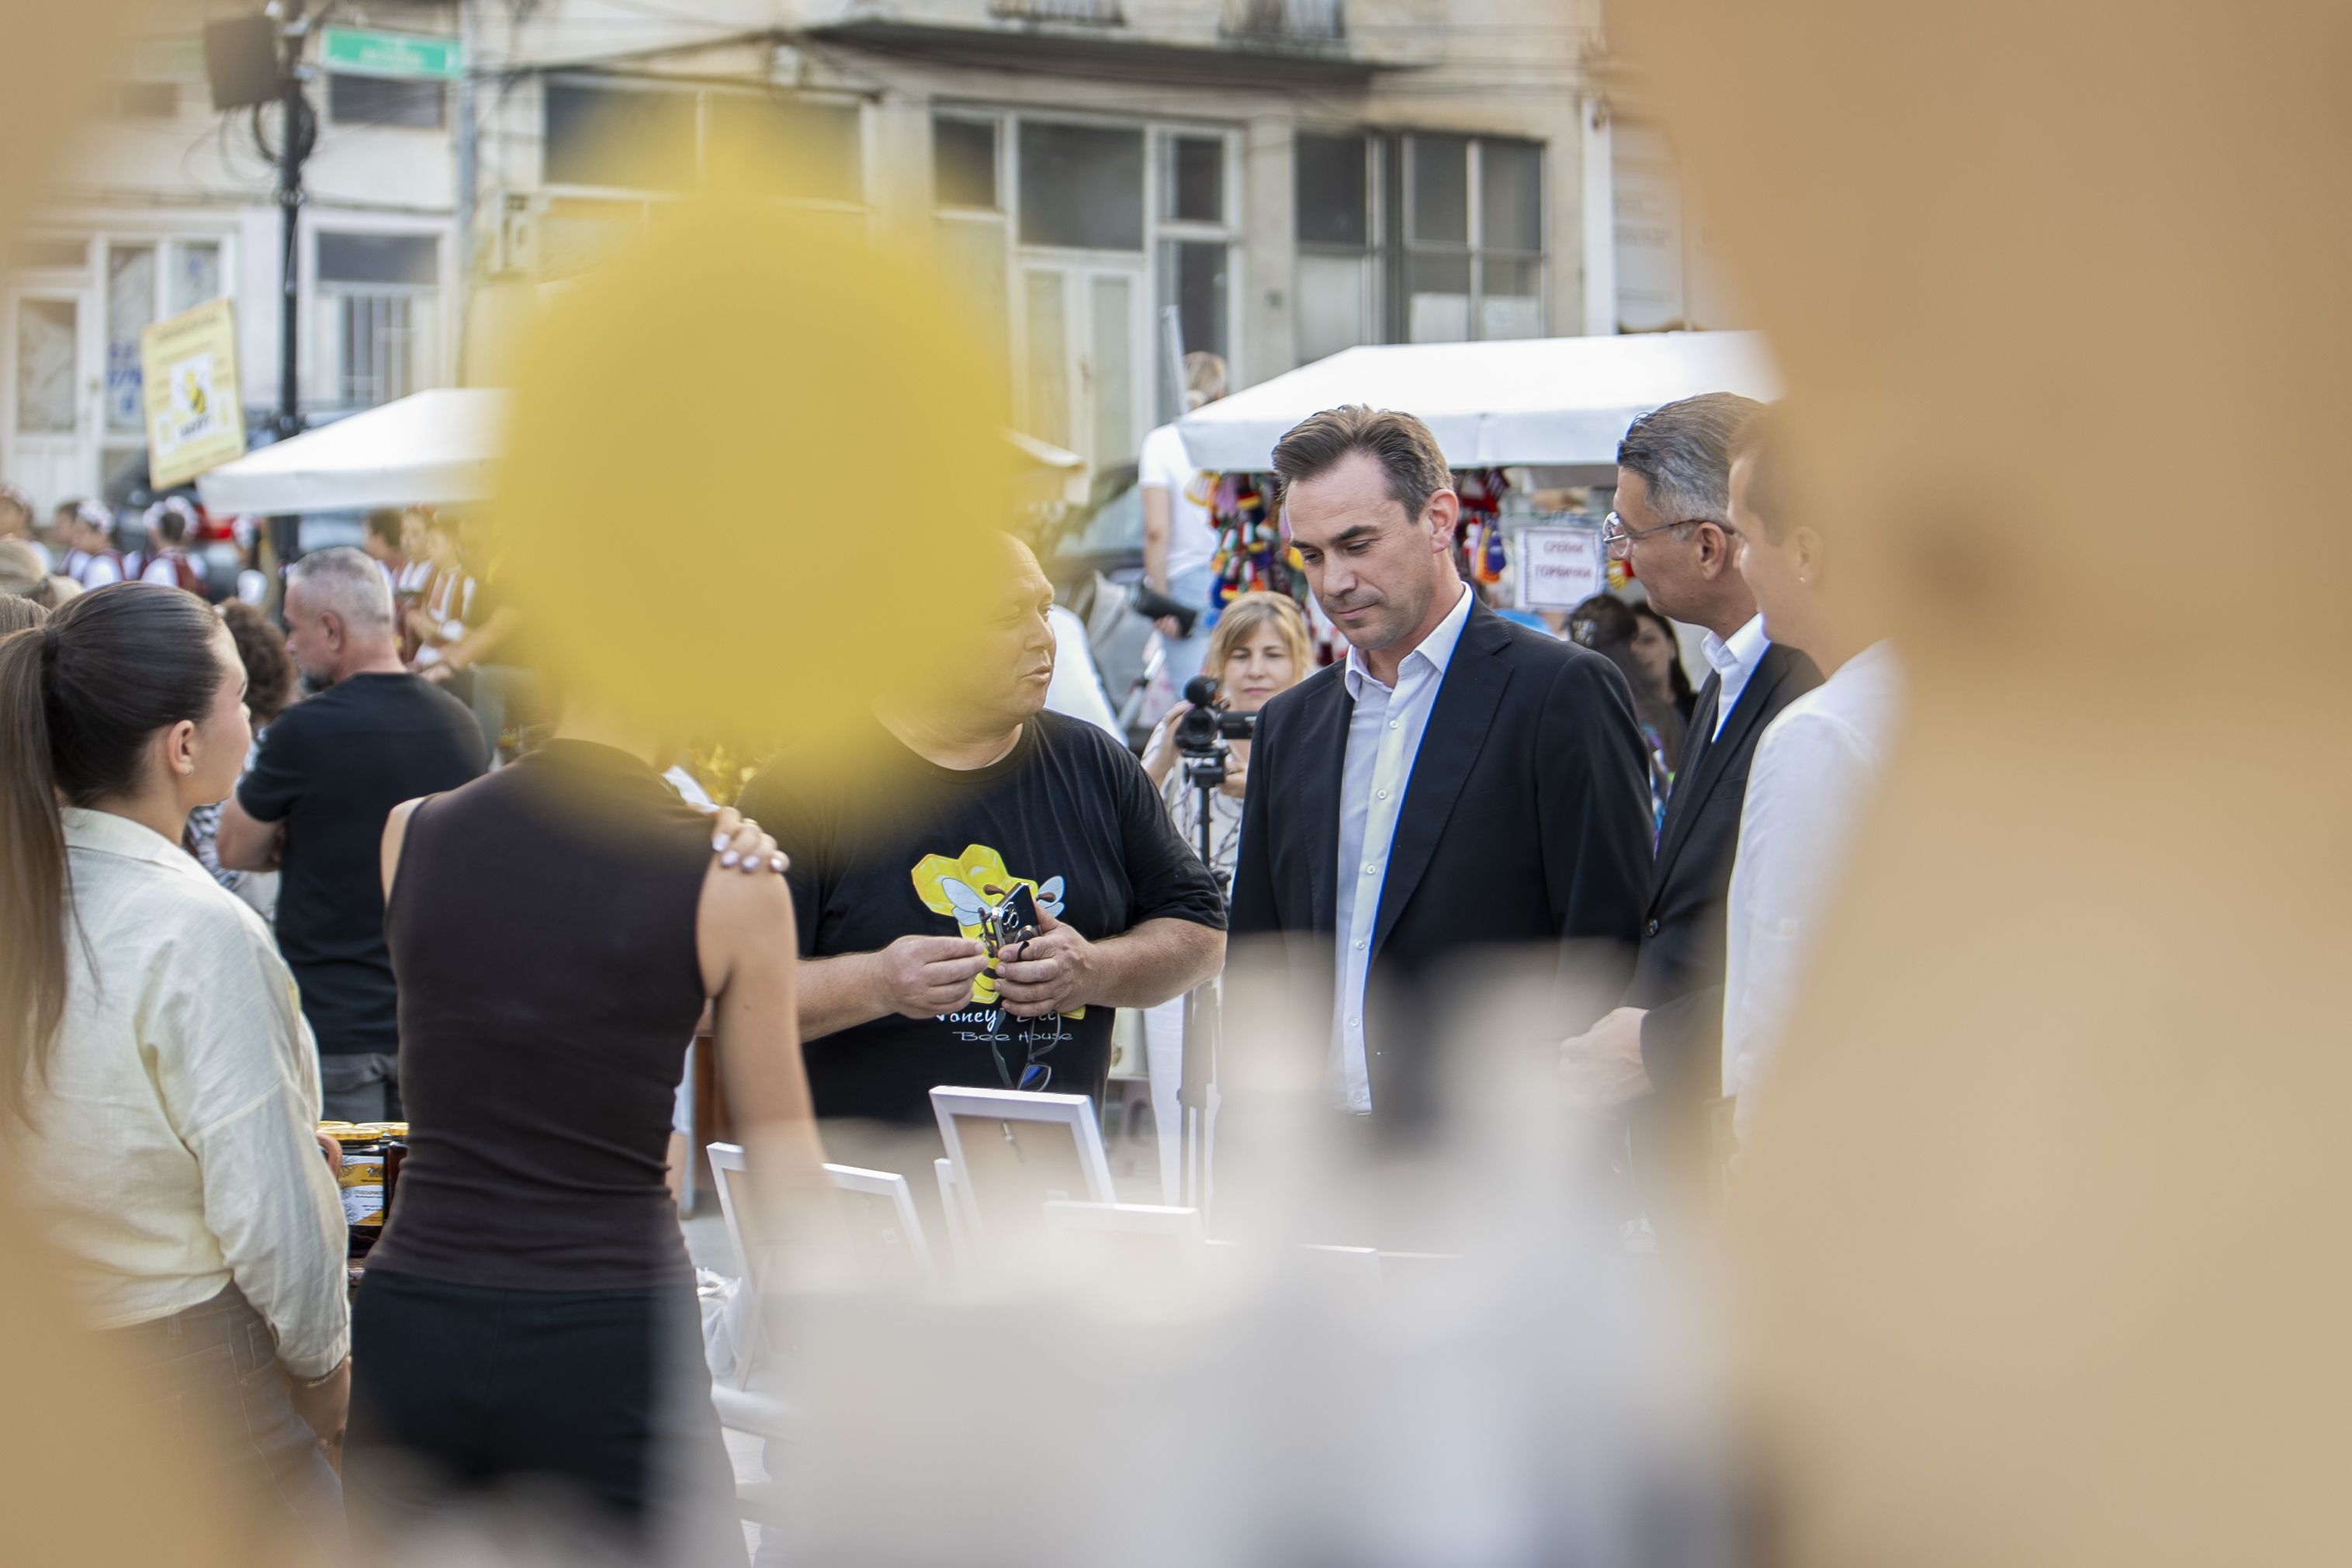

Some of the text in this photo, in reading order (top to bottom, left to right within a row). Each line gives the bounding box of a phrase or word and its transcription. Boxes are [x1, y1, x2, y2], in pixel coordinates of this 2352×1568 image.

[936, 1009, 997, 1033] oney
[952, 1031, 1073, 1044] Bee House
